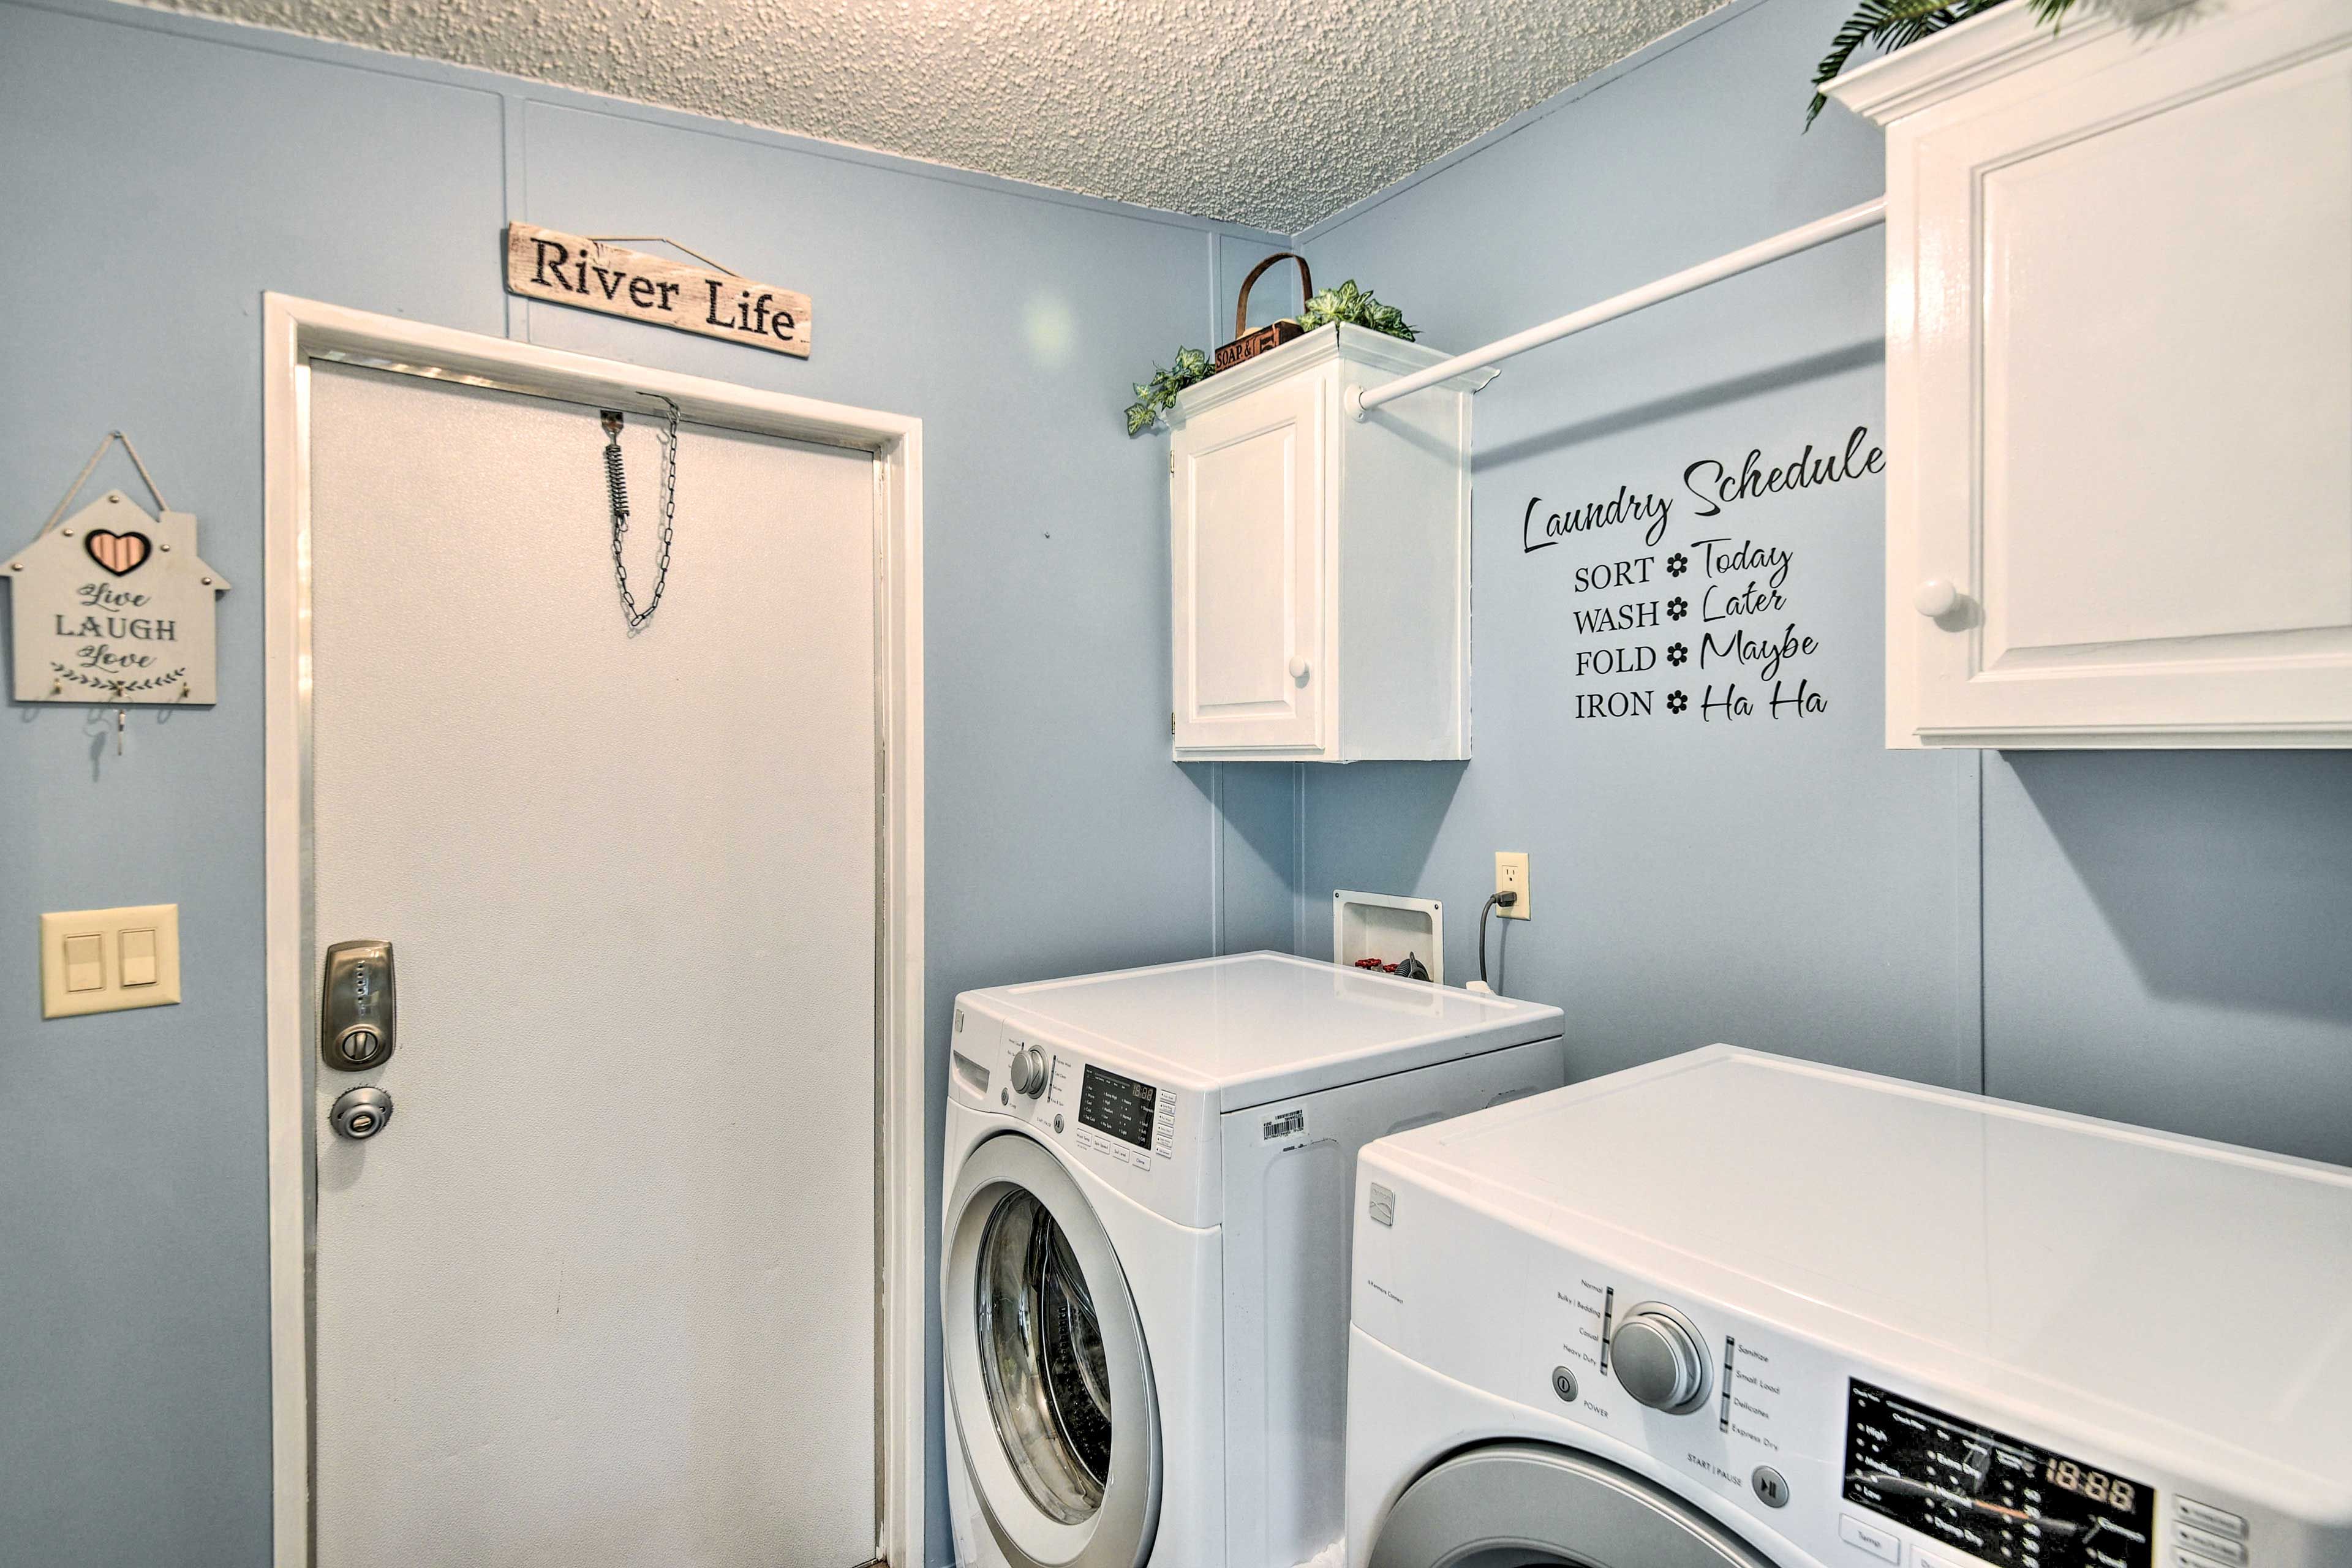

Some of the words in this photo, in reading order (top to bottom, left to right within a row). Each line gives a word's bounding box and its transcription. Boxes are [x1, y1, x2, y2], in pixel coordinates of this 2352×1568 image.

[530, 237, 679, 311] River
[705, 279, 795, 341] Life
[1245, 341, 1251, 357] &
[1524, 485, 1673, 552] Laundry
[1684, 426, 1886, 516] Schedule
[1574, 557, 1654, 592] SORT
[1691, 538, 1793, 588] Today
[77, 582, 151, 612] Live
[1573, 601, 1660, 635] WASH
[1703, 581, 1787, 622] Later
[55, 614, 176, 641] LAUGH
[77, 644, 157, 674] Love
[1575, 646, 1656, 676] FOLD
[1700, 624, 1819, 681] Maybe
[1575, 690, 1654, 718] IRON
[1700, 683, 1753, 722] Ha
[1770, 679, 1827, 720] Ha
[1736, 1370, 1757, 1386] Small
[1758, 1378, 1781, 1395] Load
[1583, 1400, 1609, 1419] POWER
[1733, 1396, 1770, 1420] Delicates
[1732, 1423, 1762, 1446] Express
[1866, 1424, 1888, 1442] High
[1687, 1452, 1712, 1471] START
[1715, 1467, 1743, 1487] PAUSE
[1857, 1530, 1882, 1548] Temp
